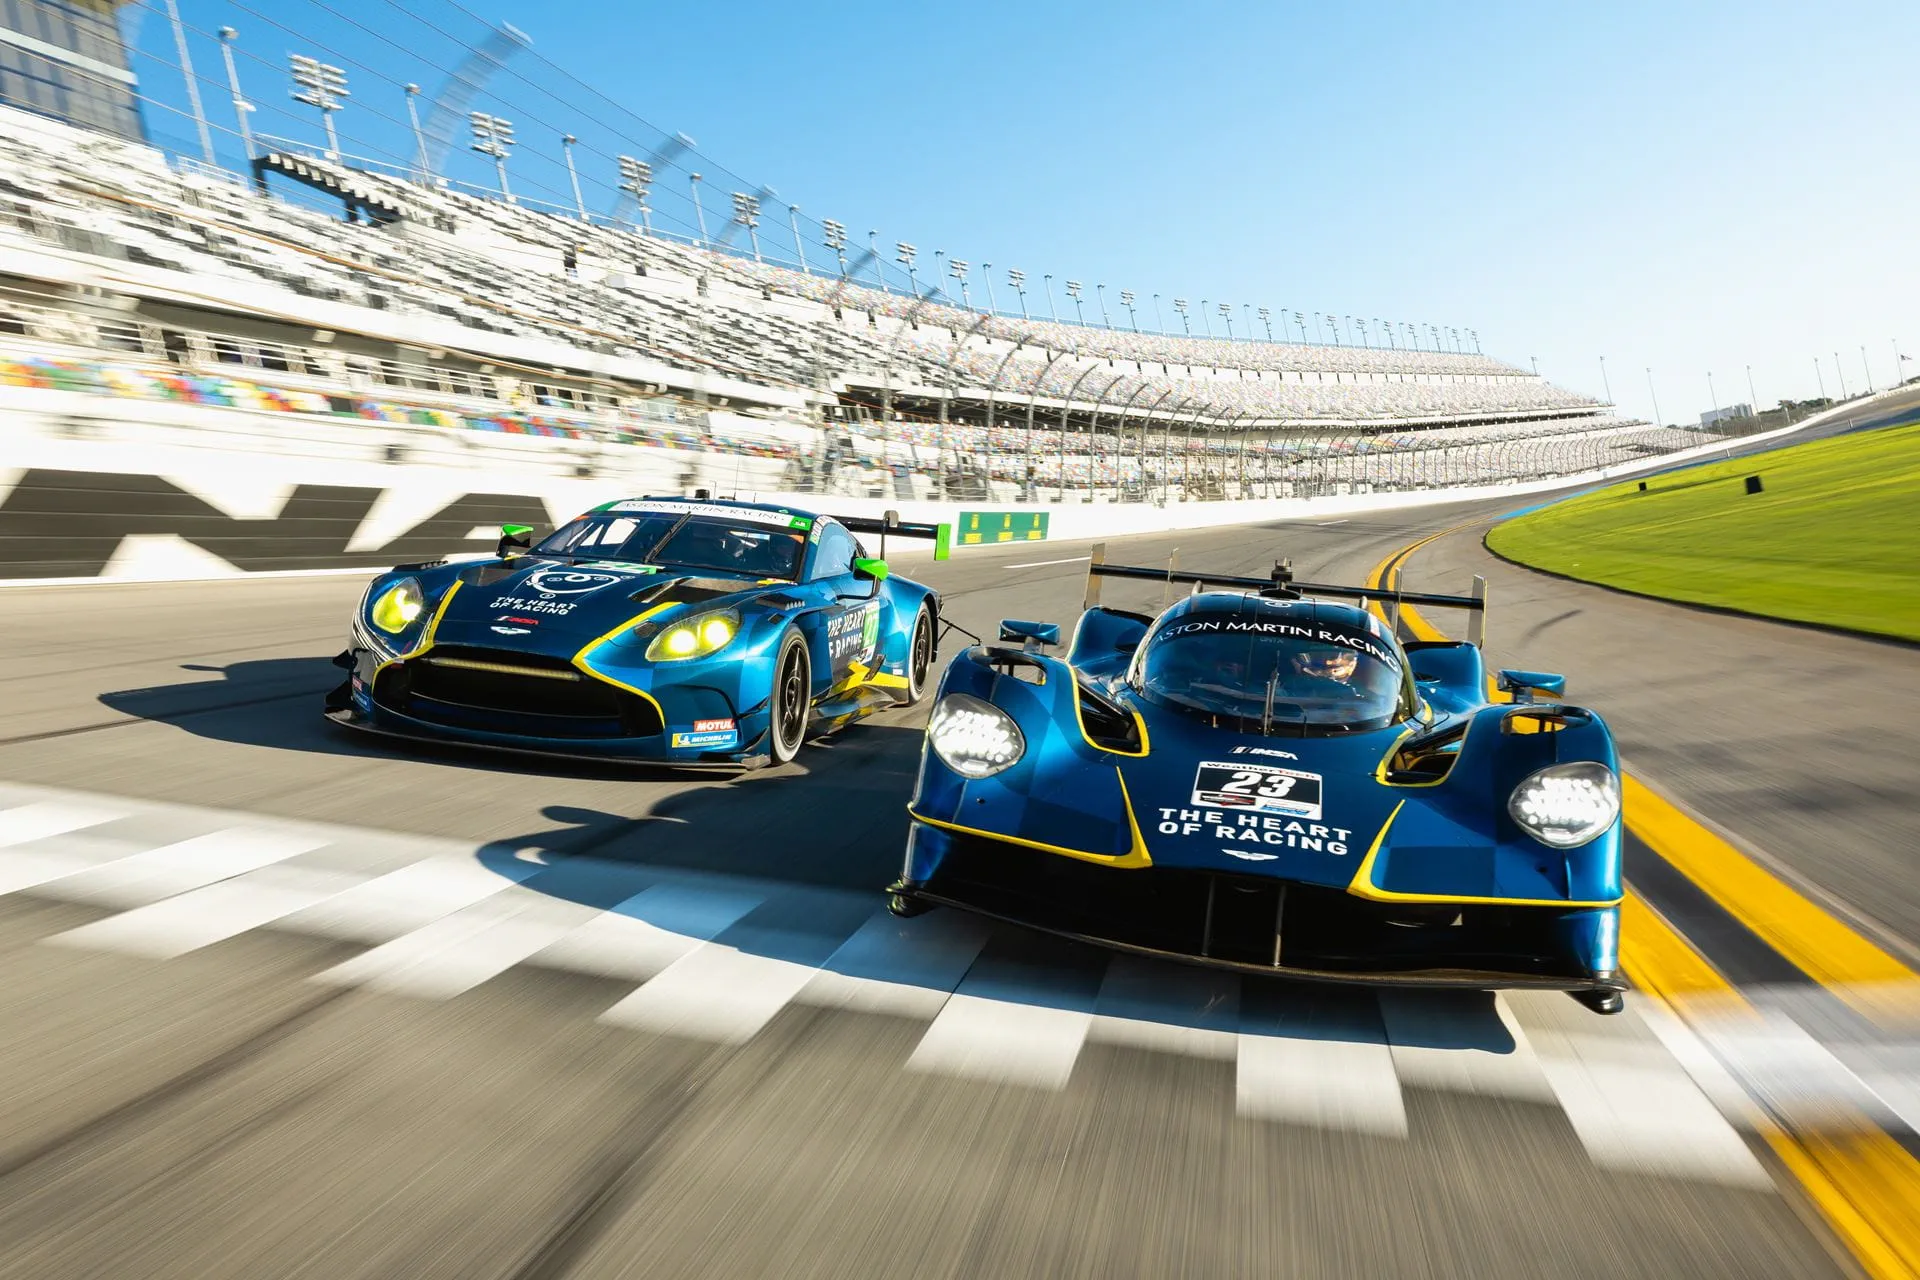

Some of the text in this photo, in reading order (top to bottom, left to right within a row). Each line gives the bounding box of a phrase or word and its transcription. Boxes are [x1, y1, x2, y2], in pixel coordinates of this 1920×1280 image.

[495, 597, 578, 610] THE HEART
[512, 602, 569, 616] RACING
[828, 609, 866, 637] THE HEART
[1156, 621, 1399, 672] ASTON MARTIN RACING
[697, 720, 733, 731] MOTUL
[691, 734, 733, 743] MICHELIN
[1249, 747, 1299, 761] IMSA
[1206, 762, 1316, 779] WeatherTech
[1220, 771, 1297, 798] 23
[1158, 808, 1352, 841] THE HEART
[1158, 821, 1349, 856] OF RACING
